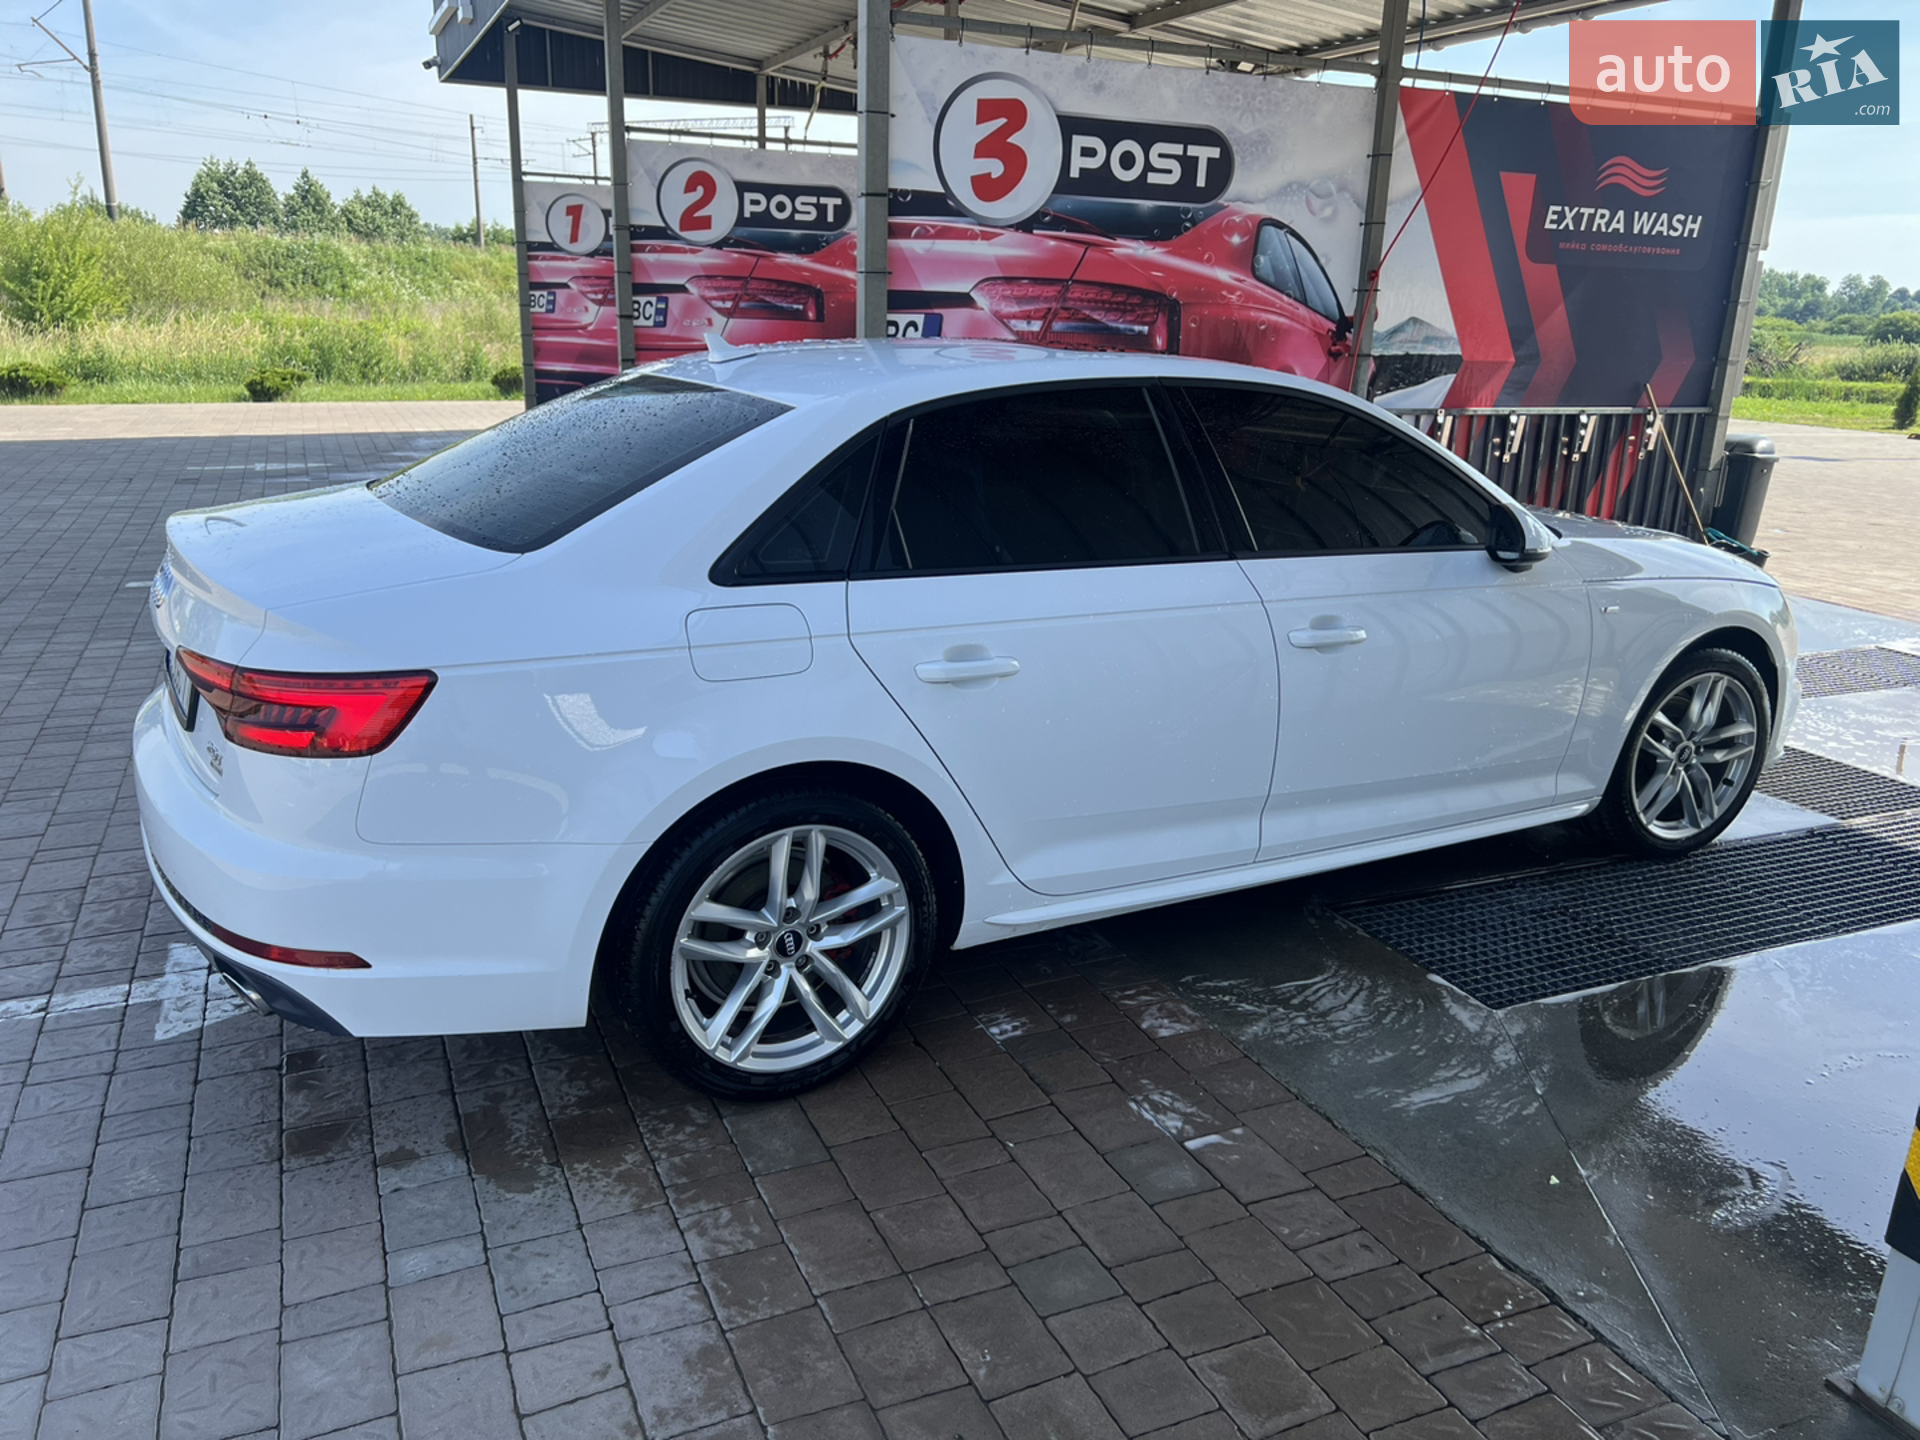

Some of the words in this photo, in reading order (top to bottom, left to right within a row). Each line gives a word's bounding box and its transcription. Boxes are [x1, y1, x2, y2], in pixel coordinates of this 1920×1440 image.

[970, 97, 1028, 202] 3
[1069, 134, 1221, 188] POST
[679, 170, 717, 232] 2
[743, 192, 843, 223] POST
[1544, 205, 1625, 234] EXTRA
[1632, 210, 1703, 238] WASH
[565, 203, 584, 244] 1
[1559, 240, 1586, 250] мийка
[1590, 243, 1681, 255] самообслуговування
